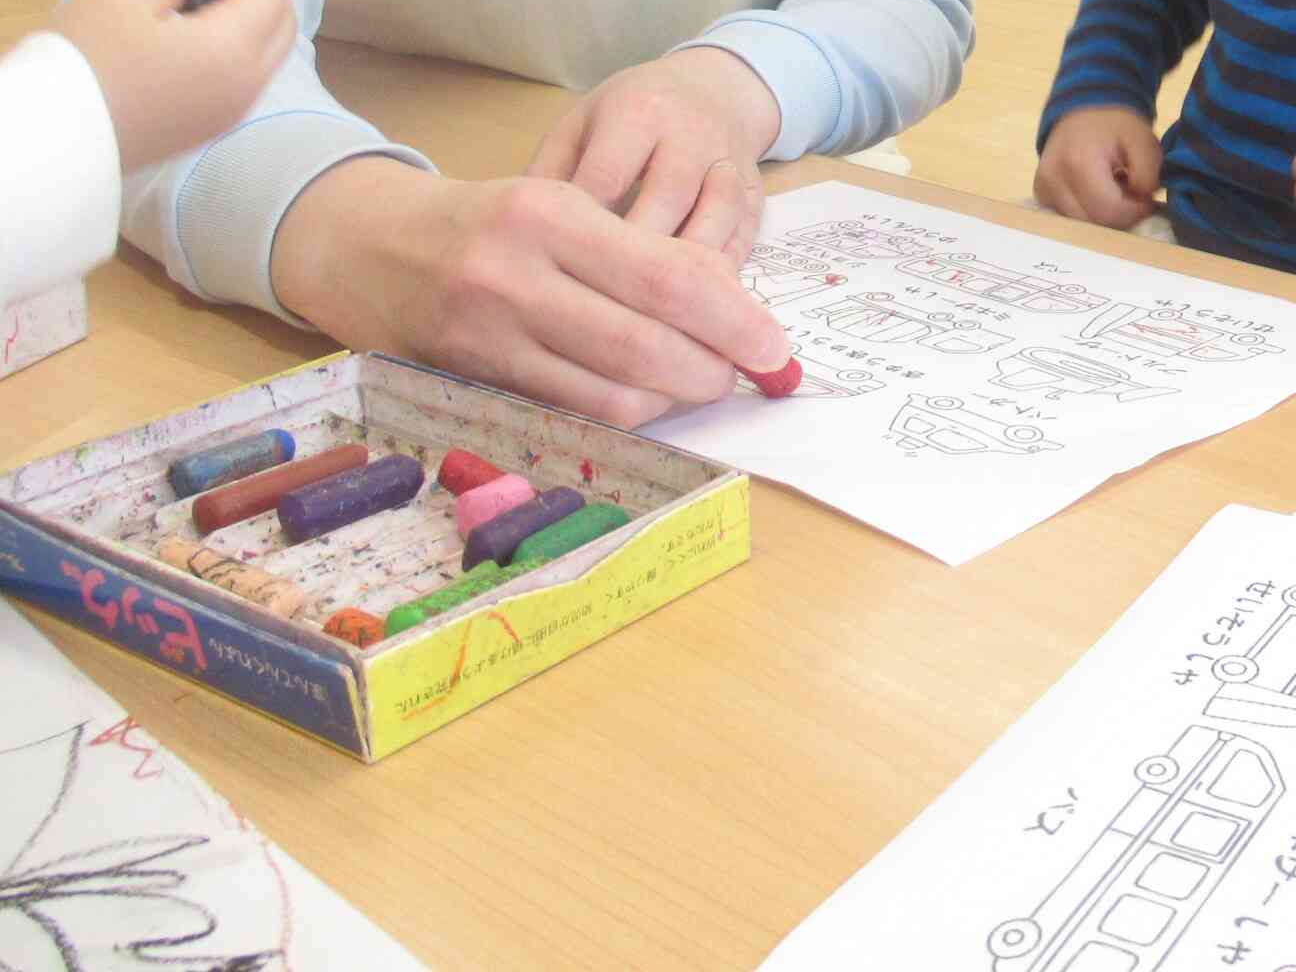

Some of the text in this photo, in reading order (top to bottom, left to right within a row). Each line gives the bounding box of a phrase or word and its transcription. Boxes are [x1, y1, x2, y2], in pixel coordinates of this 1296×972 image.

[1173, 579, 1276, 687] せいそうしゃ
[1023, 786, 1081, 838] バス
